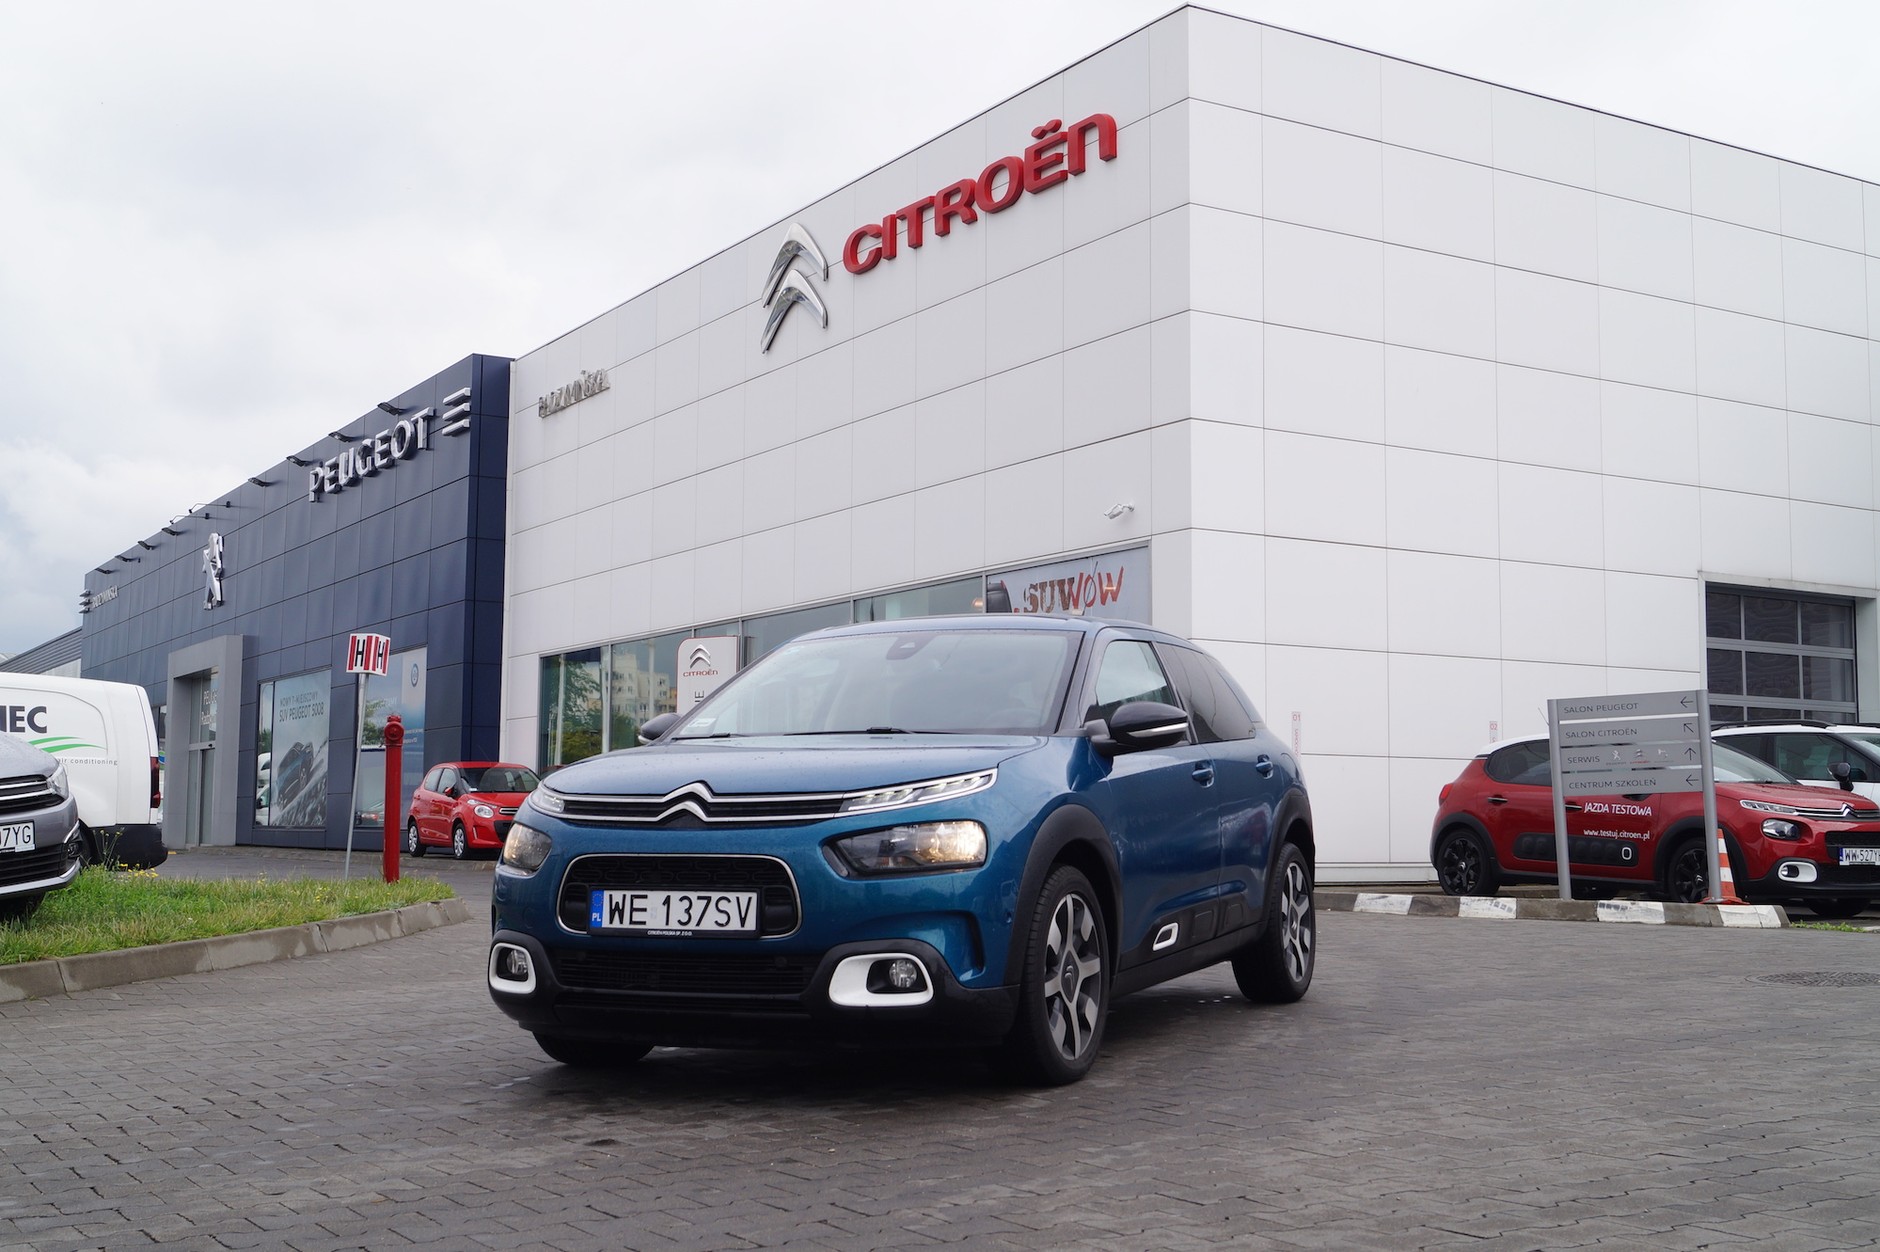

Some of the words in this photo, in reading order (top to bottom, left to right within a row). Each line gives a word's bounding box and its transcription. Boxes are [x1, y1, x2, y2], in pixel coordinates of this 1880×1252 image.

[309, 406, 436, 502] PEUGEOT
[354, 639, 366, 667] H
[376, 641, 386, 669] H
[683, 668, 718, 677] CITROËN
[1563, 705, 1593, 714] SALON
[1596, 702, 1639, 712] PEUGEOT
[1565, 730, 1595, 739] SALON
[1597, 728, 1638, 737] CITROËN
[70, 758, 118, 766] conditioning
[1567, 755, 1600, 764] SERWIS
[1568, 780, 1613, 790] CENTRUM
[1615, 778, 1657, 788] SZKOLEŃ
[1584, 802, 1610, 813] JAZDA
[1611, 804, 1652, 816] TESTOWA
[0, 825, 31, 847] 7YG
[592, 912, 602, 922] PL
[608, 893, 649, 926] WE
[661, 894, 753, 929] 137SV
